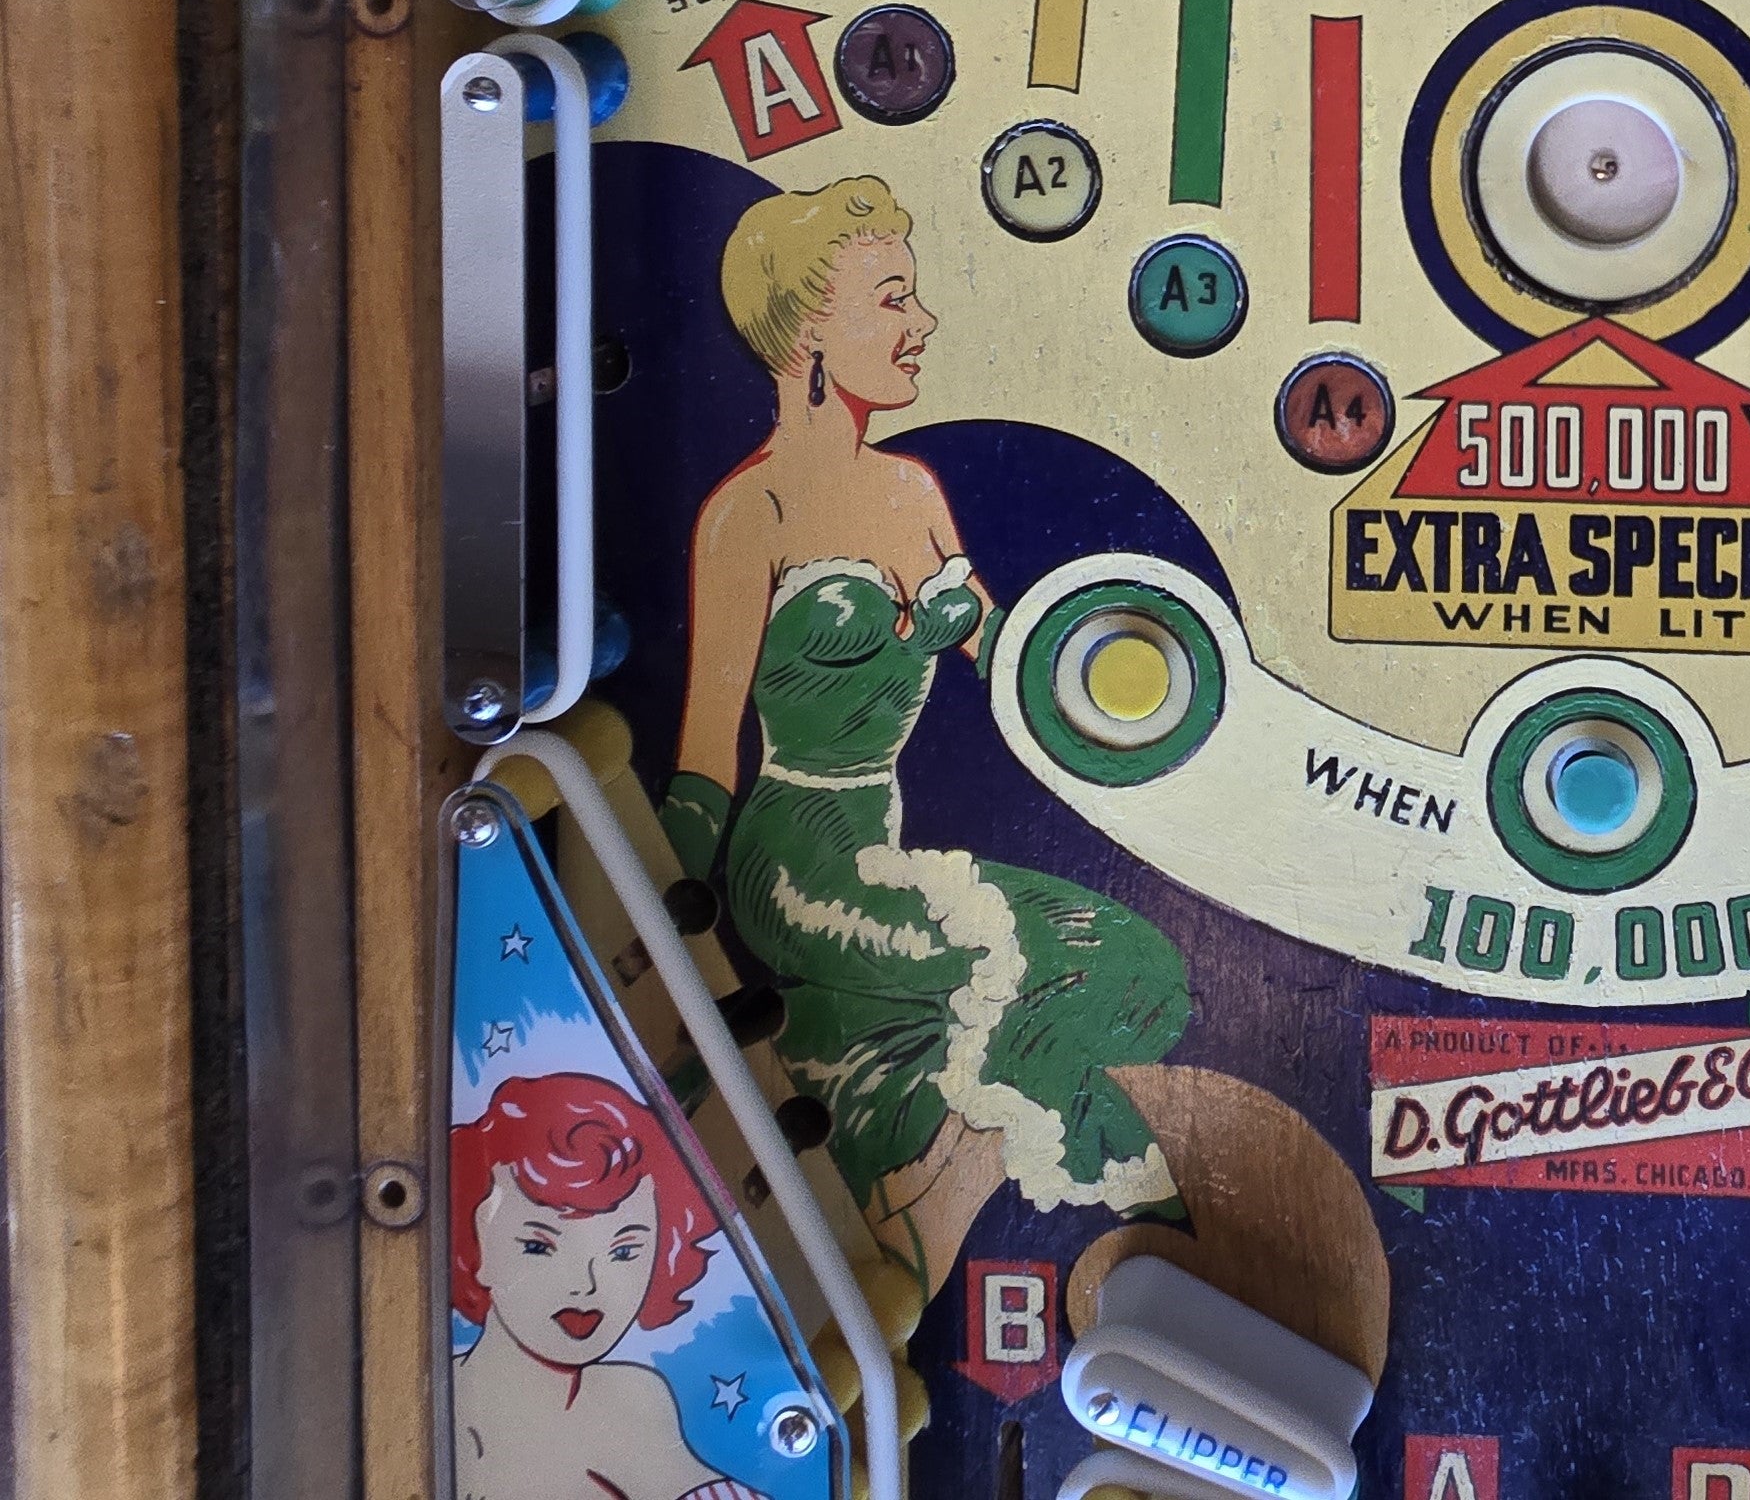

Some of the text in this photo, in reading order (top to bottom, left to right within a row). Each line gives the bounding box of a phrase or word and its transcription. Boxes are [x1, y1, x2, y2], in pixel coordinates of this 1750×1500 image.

[744, 32, 821, 136] A
[1458, 404, 1729, 494] 500,000
[1345, 509, 1558, 597] EXTRA
[1432, 601, 1747, 639] WHEN LIT
[1305, 747, 1458, 834] WHEN
[1409, 1030, 1531, 1055] PRODUCT
[984, 1274, 1045, 1363] B
[1125, 1401, 1287, 1493] FLIPPER
